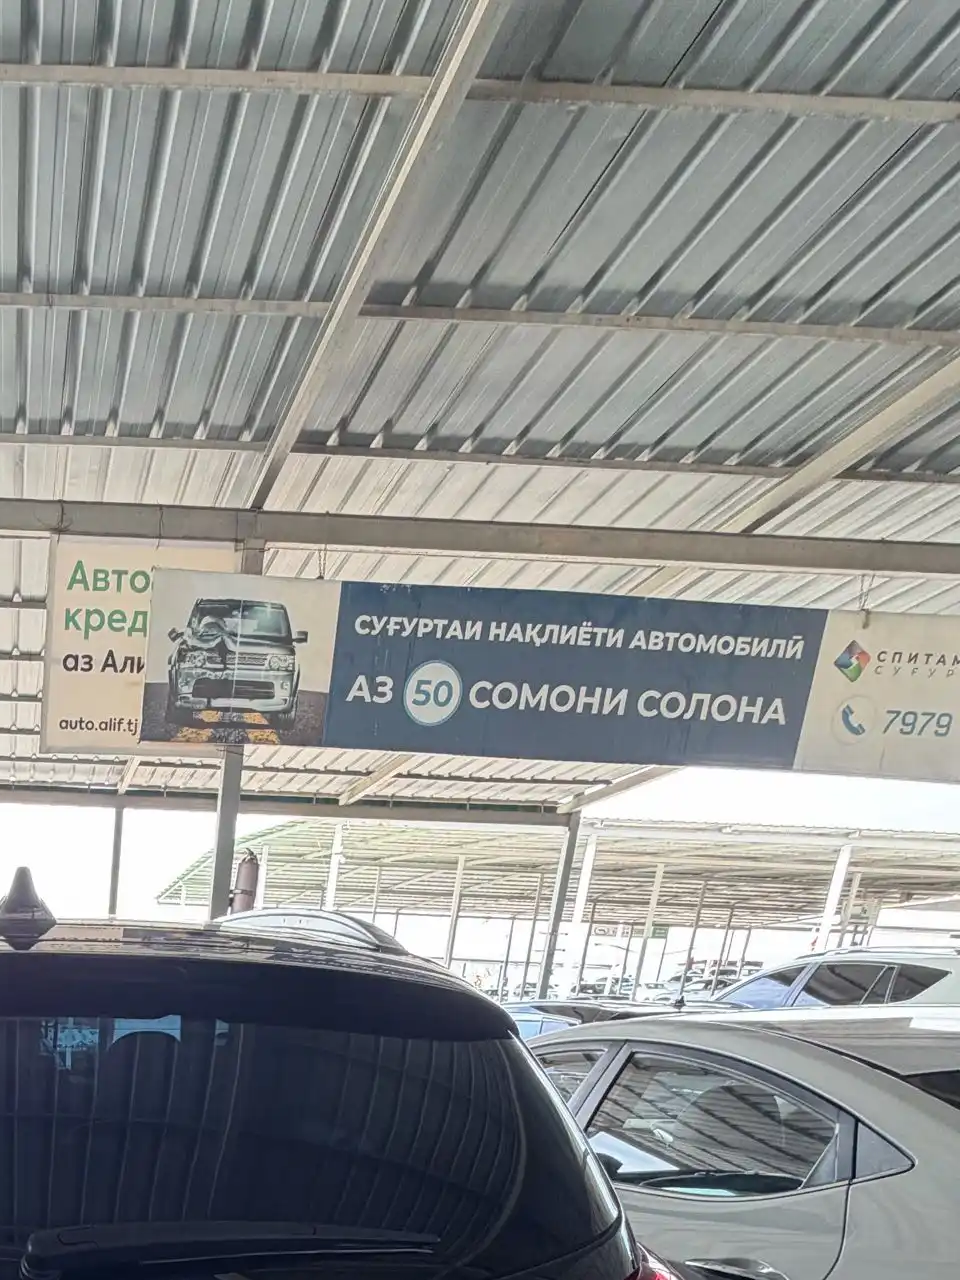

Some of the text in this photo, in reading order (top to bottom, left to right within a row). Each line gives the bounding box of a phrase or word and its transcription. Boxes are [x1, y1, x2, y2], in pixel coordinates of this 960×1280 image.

[64, 607, 148, 640] кред
[354, 614, 483, 641] СУҒУРТАИ
[488, 621, 625, 648] НАҚЛИЁТИ
[62, 652, 94, 673] аз
[345, 674, 787, 726] АЗ 50 СОМОНИ СОЛОНА
[58, 716, 139, 737] auto.alif.tj
[881, 709, 954, 738] 7979
